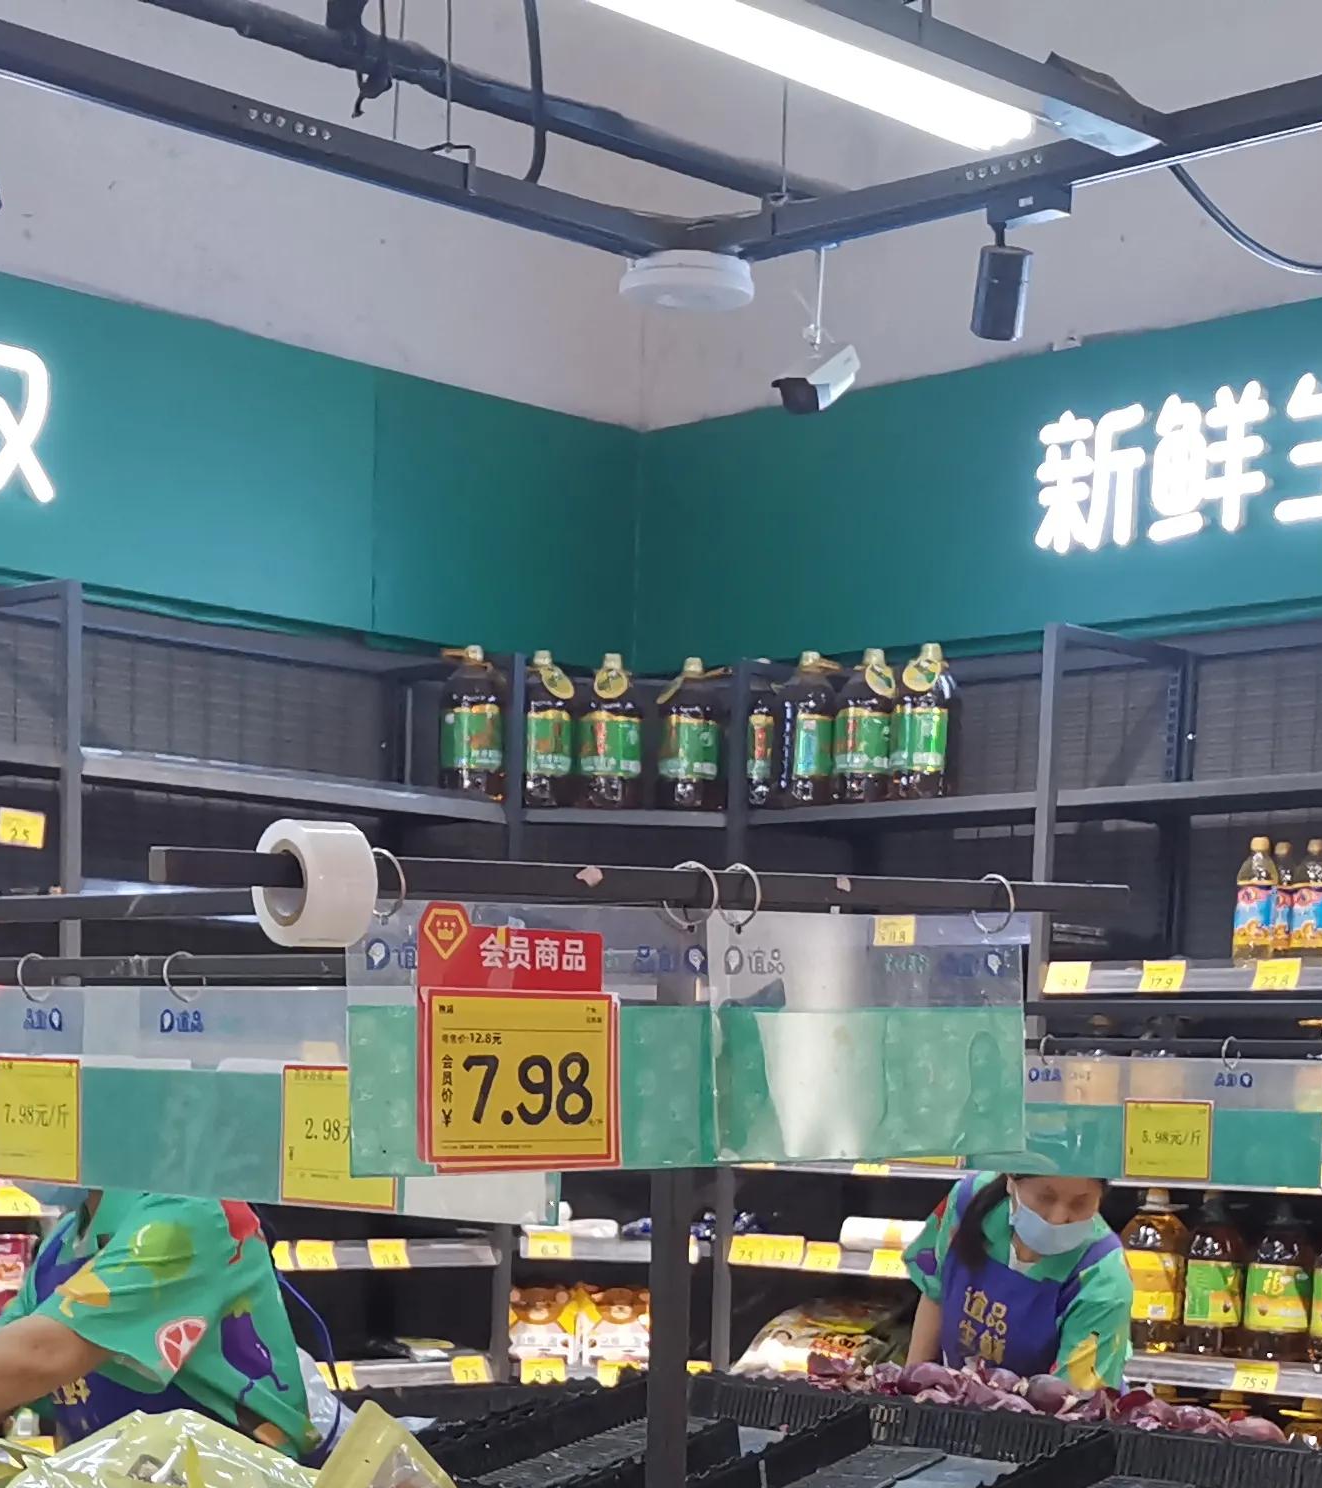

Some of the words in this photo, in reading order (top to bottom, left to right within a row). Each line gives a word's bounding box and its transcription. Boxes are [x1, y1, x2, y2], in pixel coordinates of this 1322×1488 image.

[479, 933, 586, 973] 会员商品
[441, 1054, 454, 1104] 会员价
[462, 1051, 593, 1126] 7.98
[4, 1103, 69, 1129] 7.98元/斤
